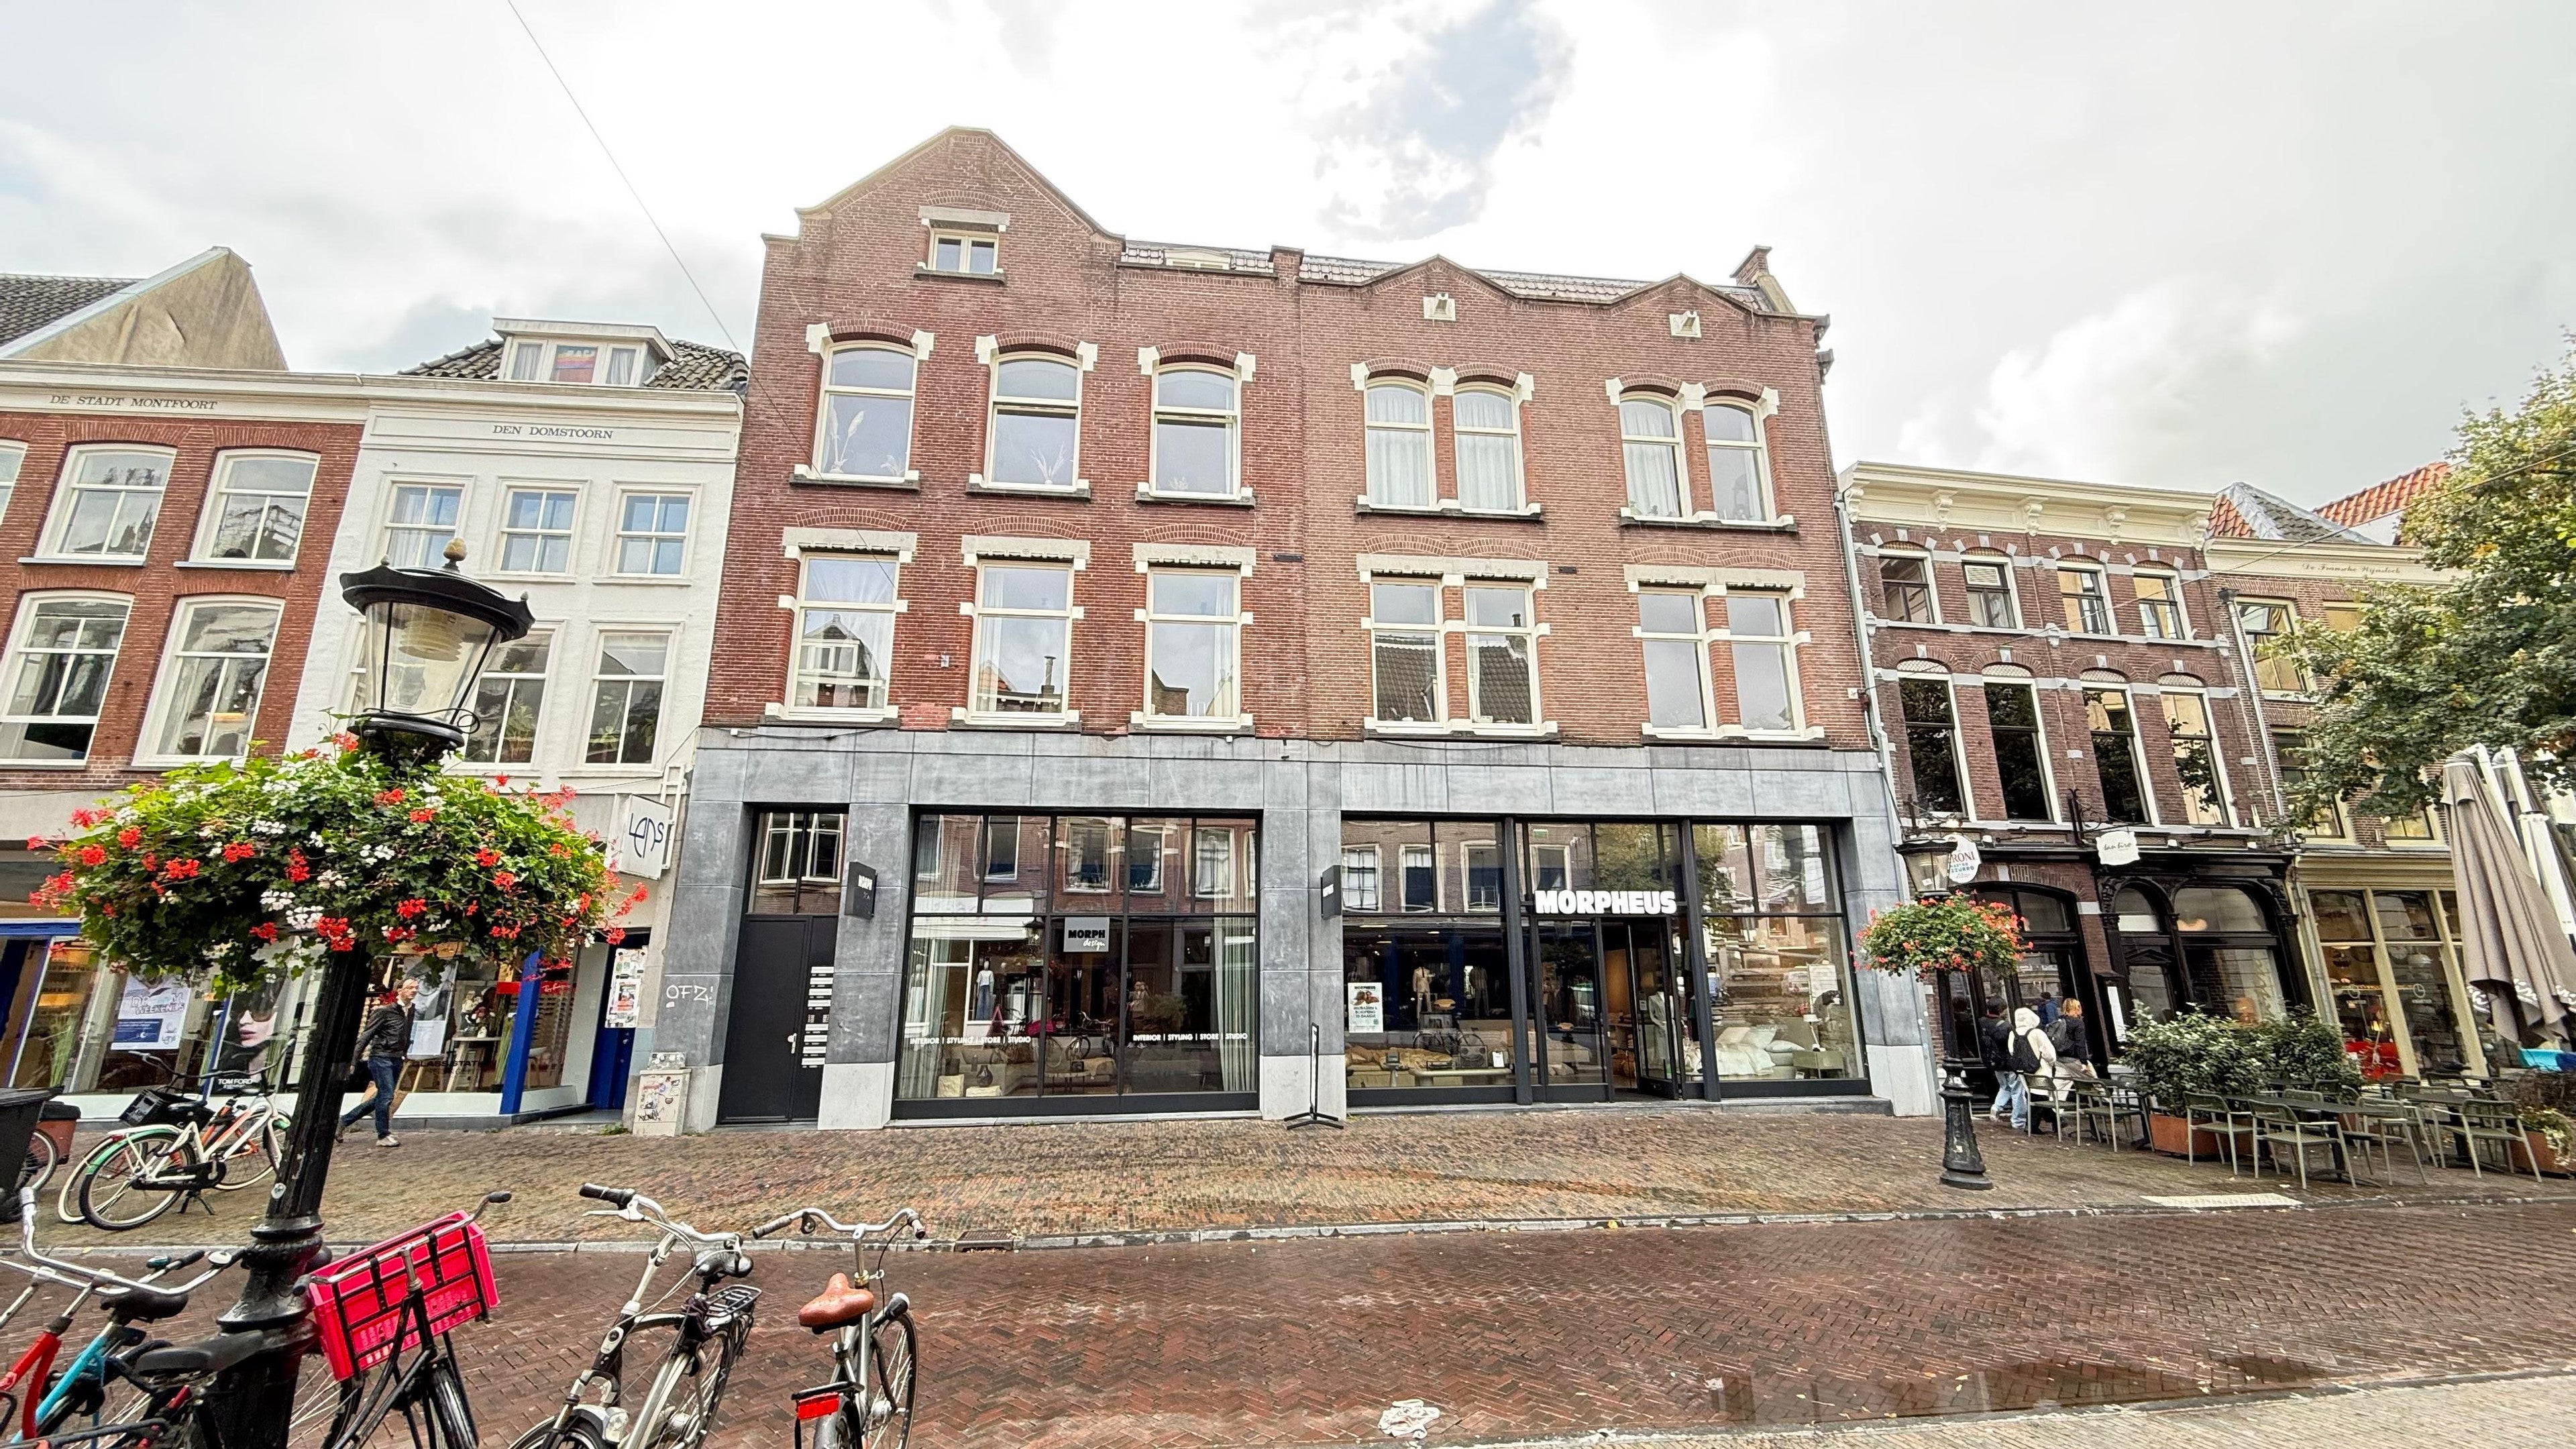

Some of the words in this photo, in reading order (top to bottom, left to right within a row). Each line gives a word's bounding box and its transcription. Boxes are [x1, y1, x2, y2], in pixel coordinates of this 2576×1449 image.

[50, 395, 70, 404] DE
[76, 396, 124, 406] STADT
[130, 398, 218, 410] MONTFOORT
[492, 425, 522, 435] DEN
[529, 427, 614, 439] DOMSTOORN
[1951, 851, 1976, 863] RONI
[1534, 890, 1677, 914] MORPHEUS
[1068, 929, 1106, 938] MORPH
[1083, 938, 1106, 951] design
